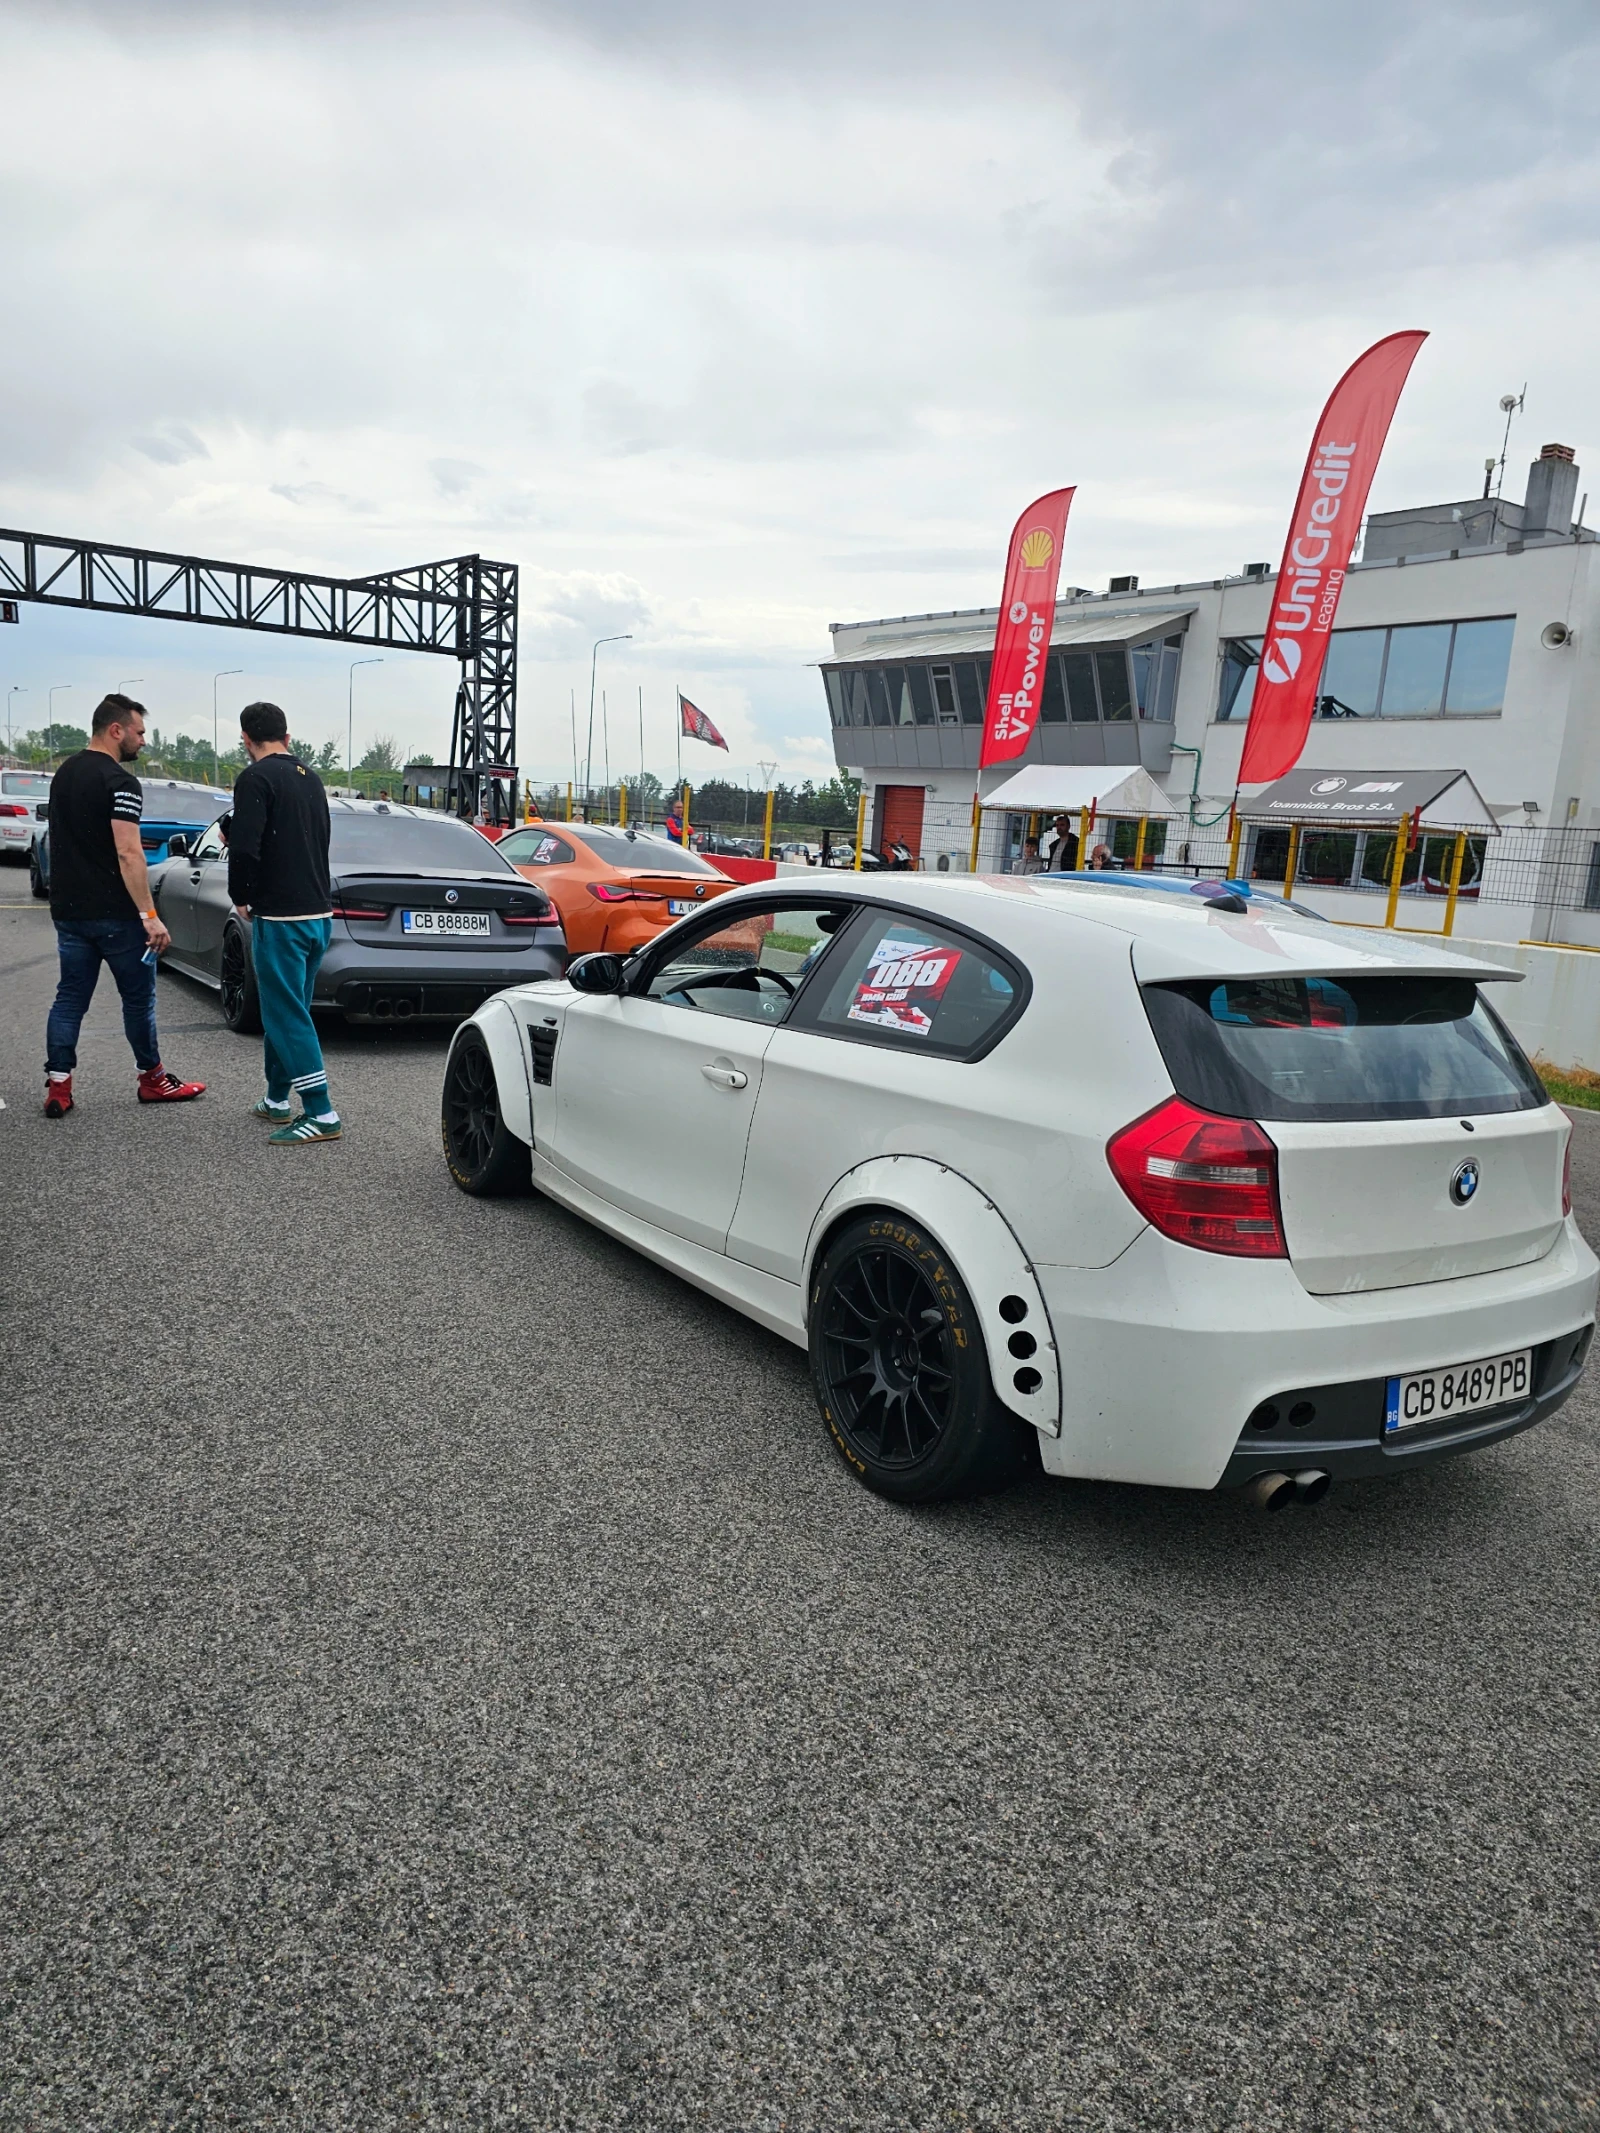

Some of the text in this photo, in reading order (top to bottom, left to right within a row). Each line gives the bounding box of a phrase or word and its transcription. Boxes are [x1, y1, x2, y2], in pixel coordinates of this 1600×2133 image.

[1275, 441, 1357, 632] UniCredit
[1313, 568, 1345, 633] Leasing
[1008, 611, 1046, 740] V-Power
[994, 693, 1013, 740] Shell
[1269, 800, 1395, 811] Ioannidis Bros S.A.
[678, 902, 685, 913] A
[869, 959, 948, 988] 088
[885, 992, 908, 1001] CUP
[1440, 1364, 1496, 1410] 8489
[1499, 1356, 1527, 1397] PB
[1386, 1411, 1398, 1423] BG
